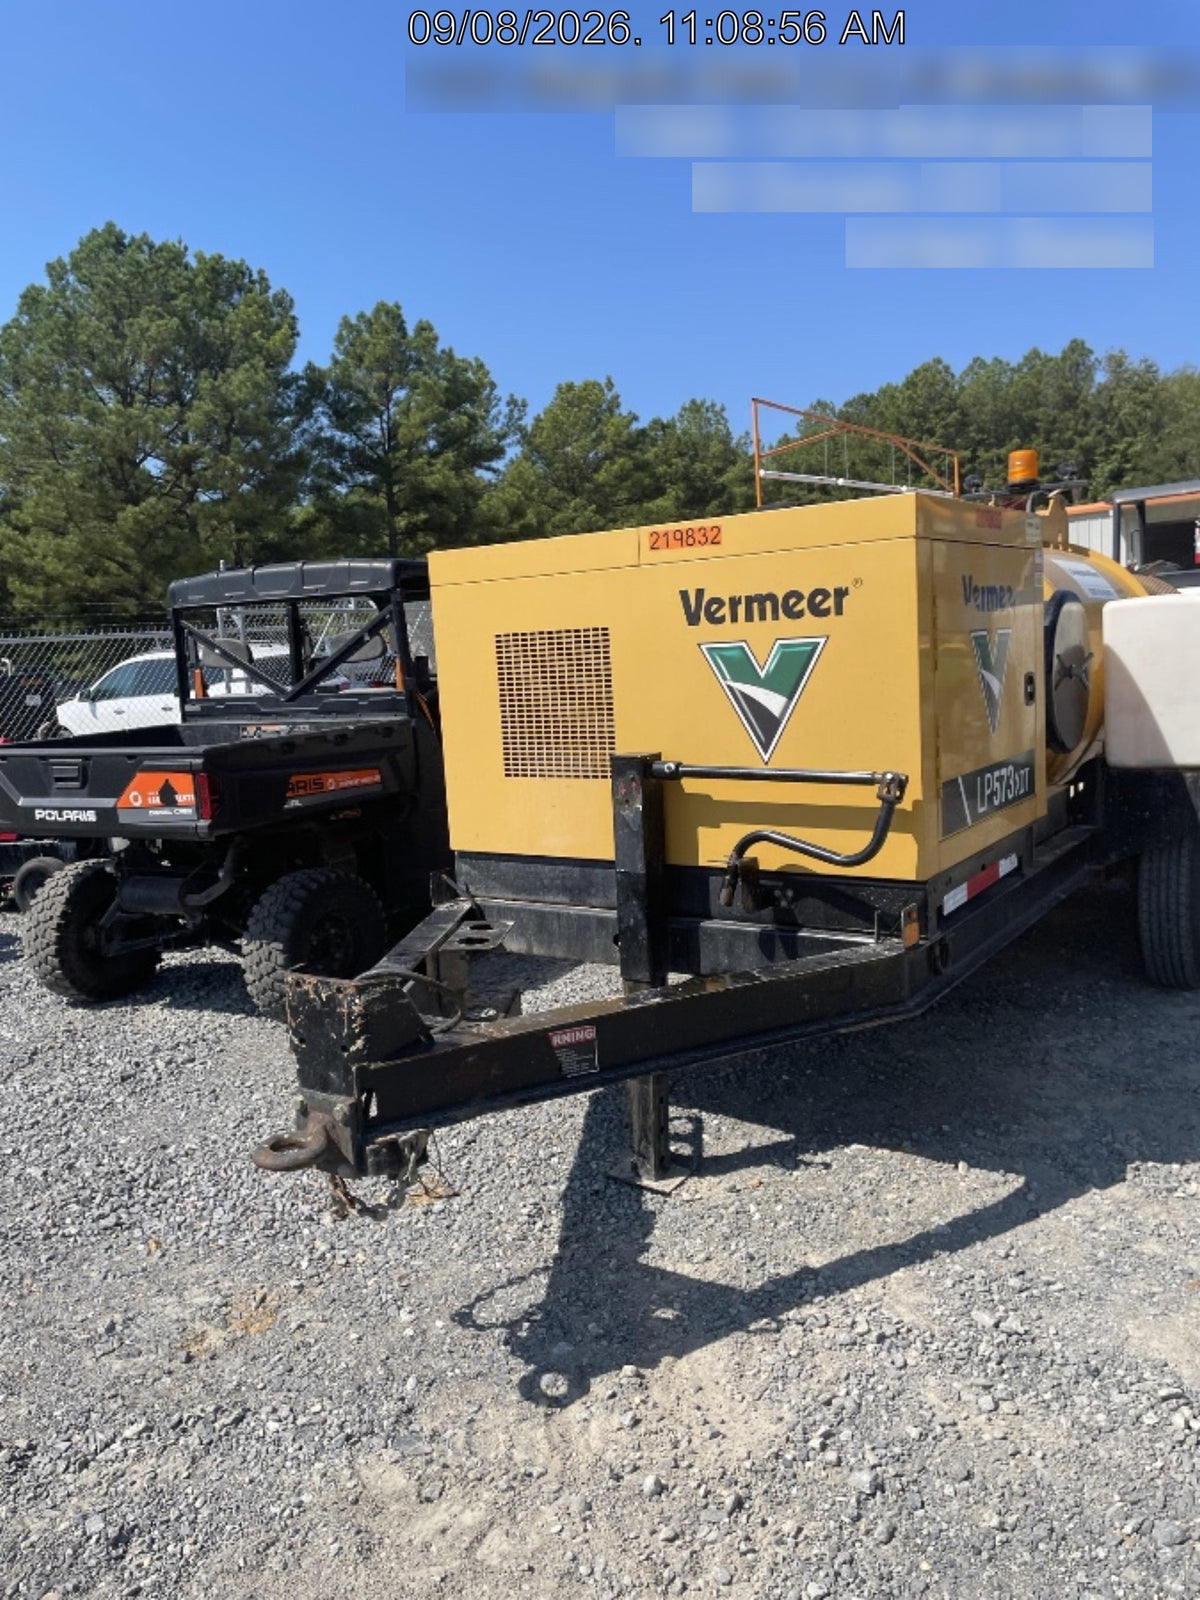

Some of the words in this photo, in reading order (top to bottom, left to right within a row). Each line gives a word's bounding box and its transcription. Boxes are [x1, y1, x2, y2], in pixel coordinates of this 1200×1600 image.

[650, 526, 722, 550] 219832
[962, 574, 1016, 612] Vermee
[679, 586, 849, 626] Vermeer
[286, 777, 325, 794] ARIS
[34, 808, 97, 822] POLARIS
[552, 1028, 594, 1047] RNING
